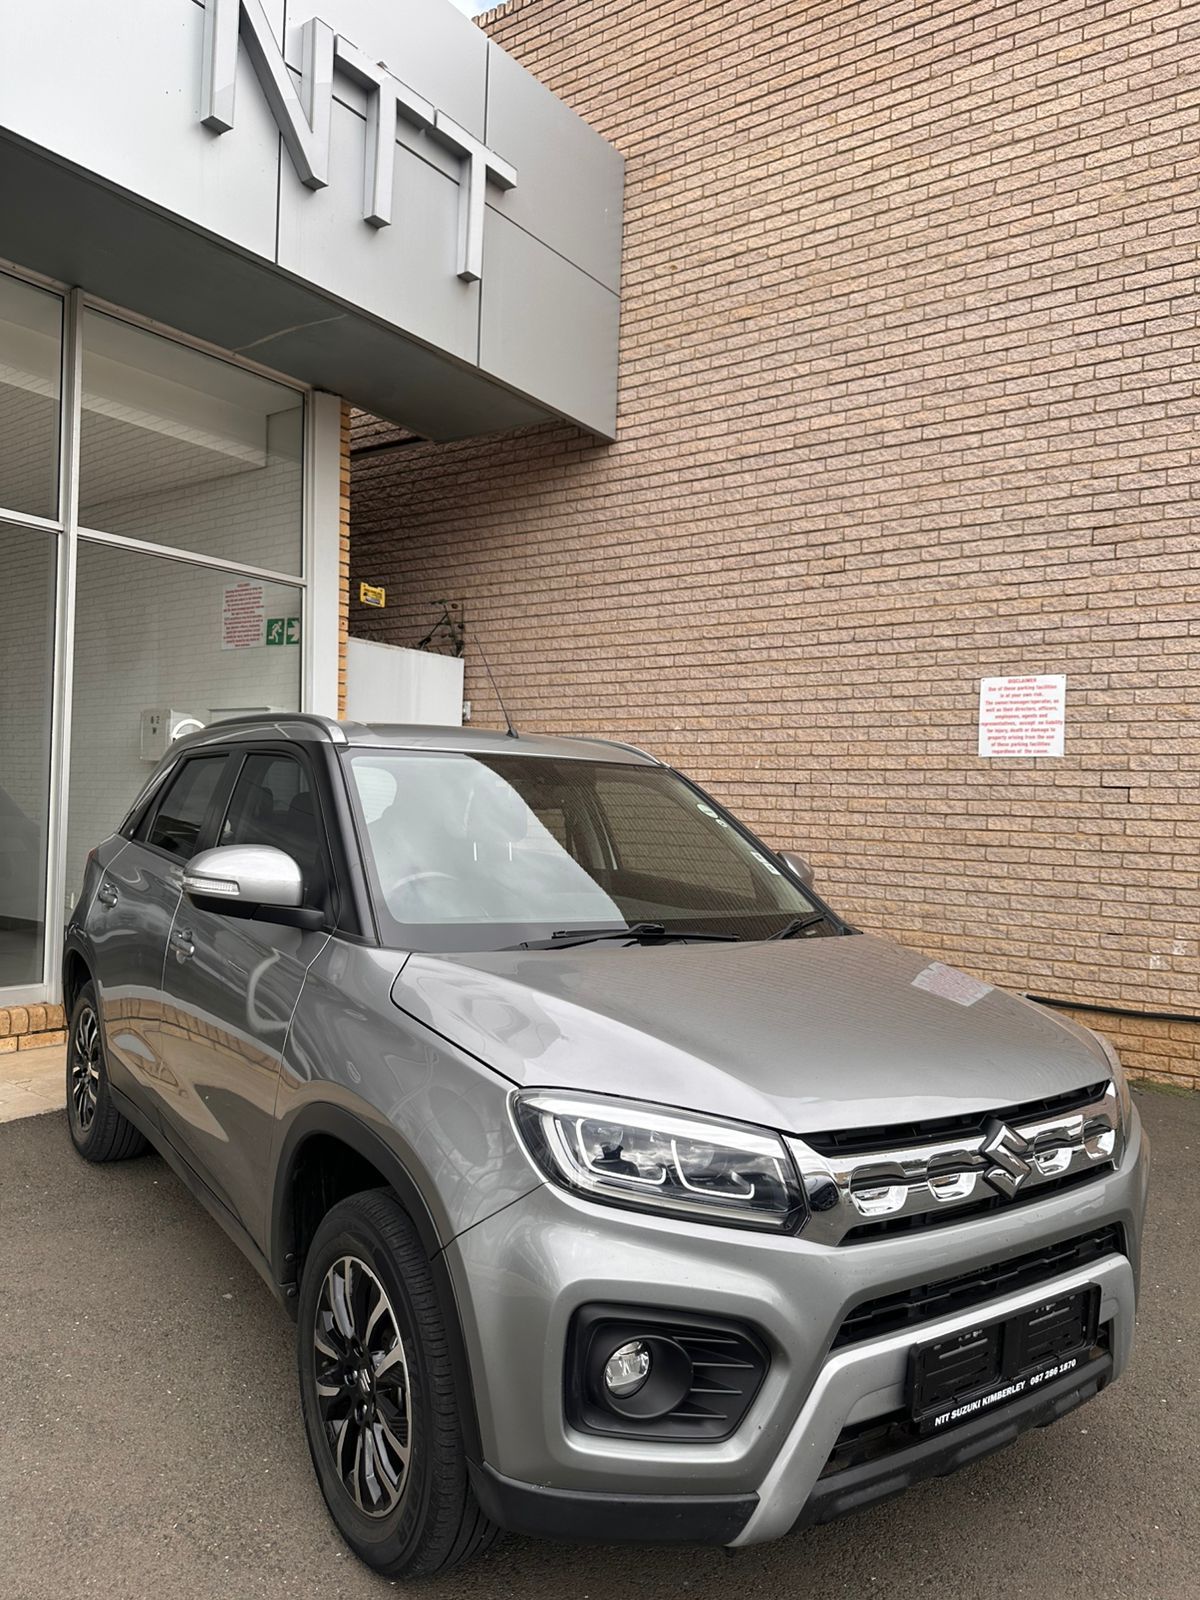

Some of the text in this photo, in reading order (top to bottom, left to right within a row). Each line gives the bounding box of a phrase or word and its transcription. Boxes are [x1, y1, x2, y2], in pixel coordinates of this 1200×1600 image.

[200, 0, 518, 282] NTT
[934, 1412, 950, 1426] NTT
[950, 1400, 981, 1419] SUZUKI
[982, 1381, 1026, 1406] KIMBERLEY
[1030, 1373, 1044, 1385] 087
[1059, 1358, 1076, 1372] 1870
